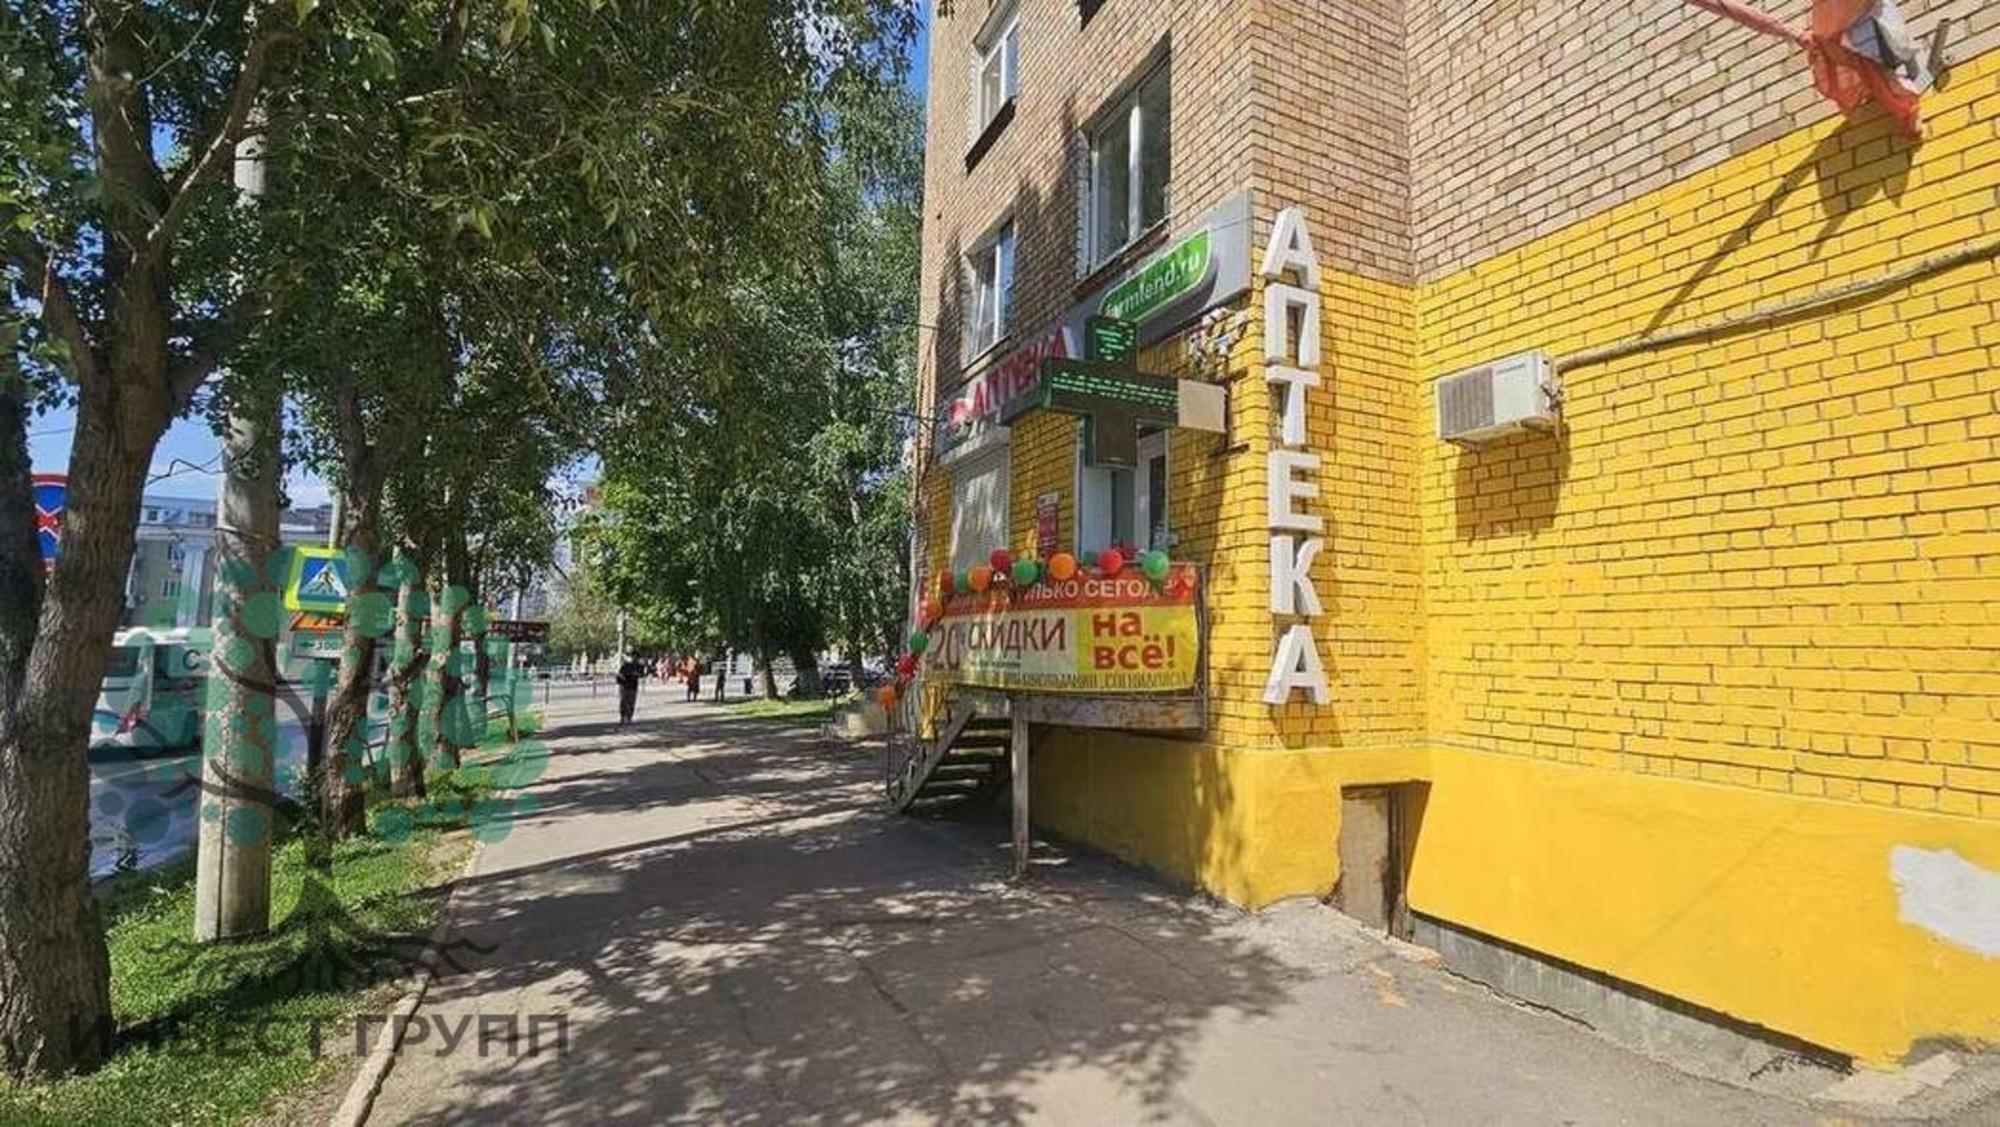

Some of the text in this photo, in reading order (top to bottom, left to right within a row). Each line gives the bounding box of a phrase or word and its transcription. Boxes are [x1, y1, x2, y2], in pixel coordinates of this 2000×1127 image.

[1261, 206, 1330, 705] АПТЕКА
[968, 617, 1066, 659] СКИДКИ
[1093, 611, 1141, 638] на
[1094, 634, 1176, 670] всё!
